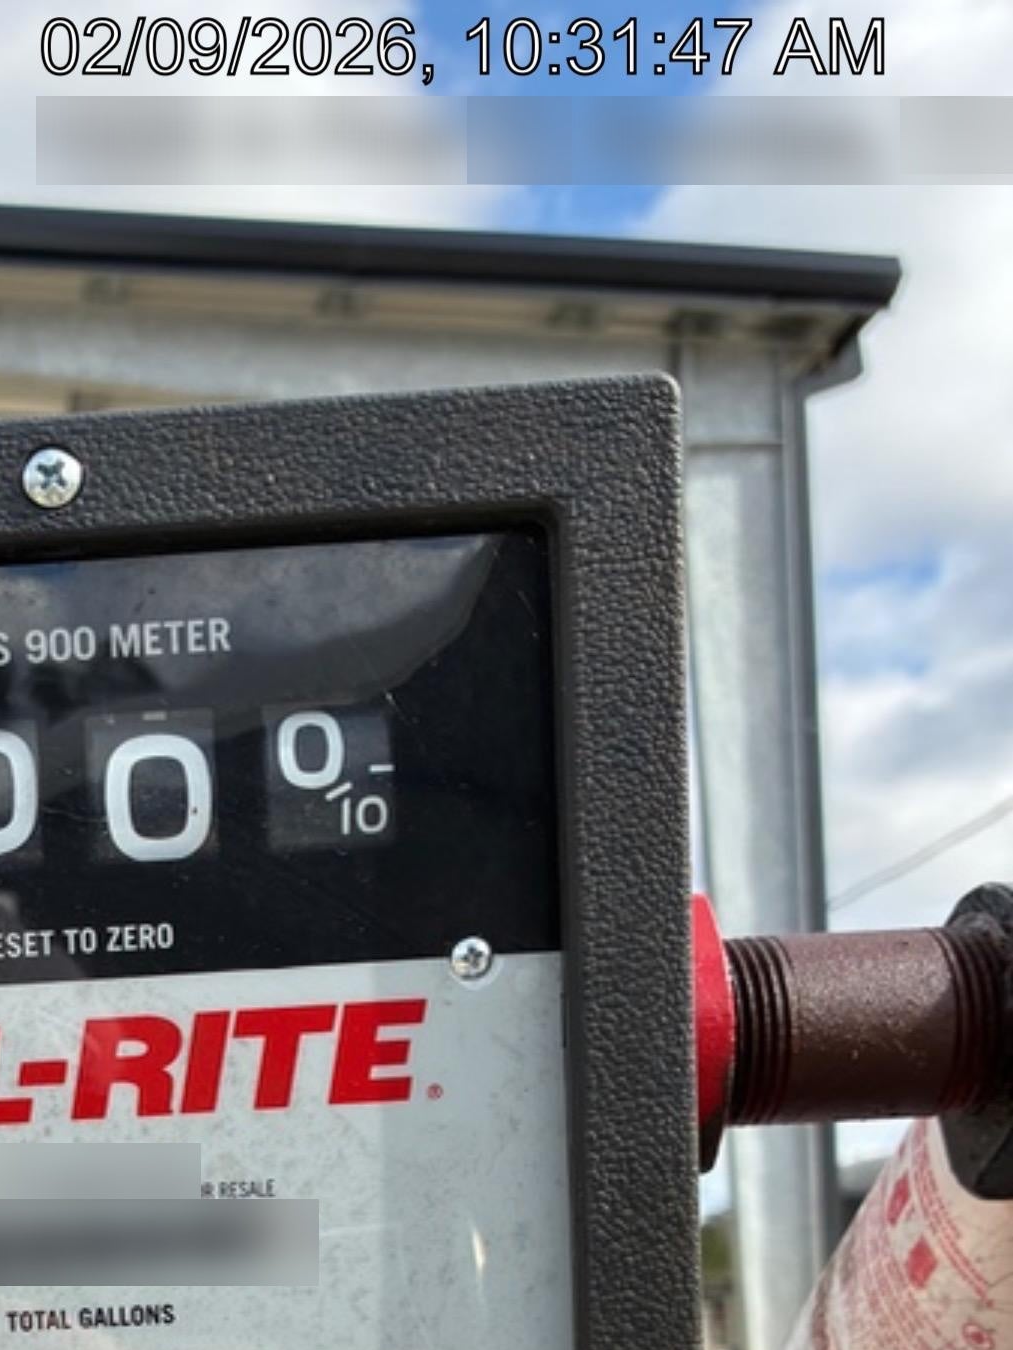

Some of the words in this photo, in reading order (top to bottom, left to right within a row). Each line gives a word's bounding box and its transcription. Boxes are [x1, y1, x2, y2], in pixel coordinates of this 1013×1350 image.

[25, 625, 97, 665] 900
[109, 617, 231, 658] METER
[62, 926, 98, 956] TO
[105, 922, 175, 952] ZERO
[218, 1178, 276, 1199] RESALE
[6, 1310, 72, 1333] TOTAL
[78, 1304, 176, 1330] GALLONS
